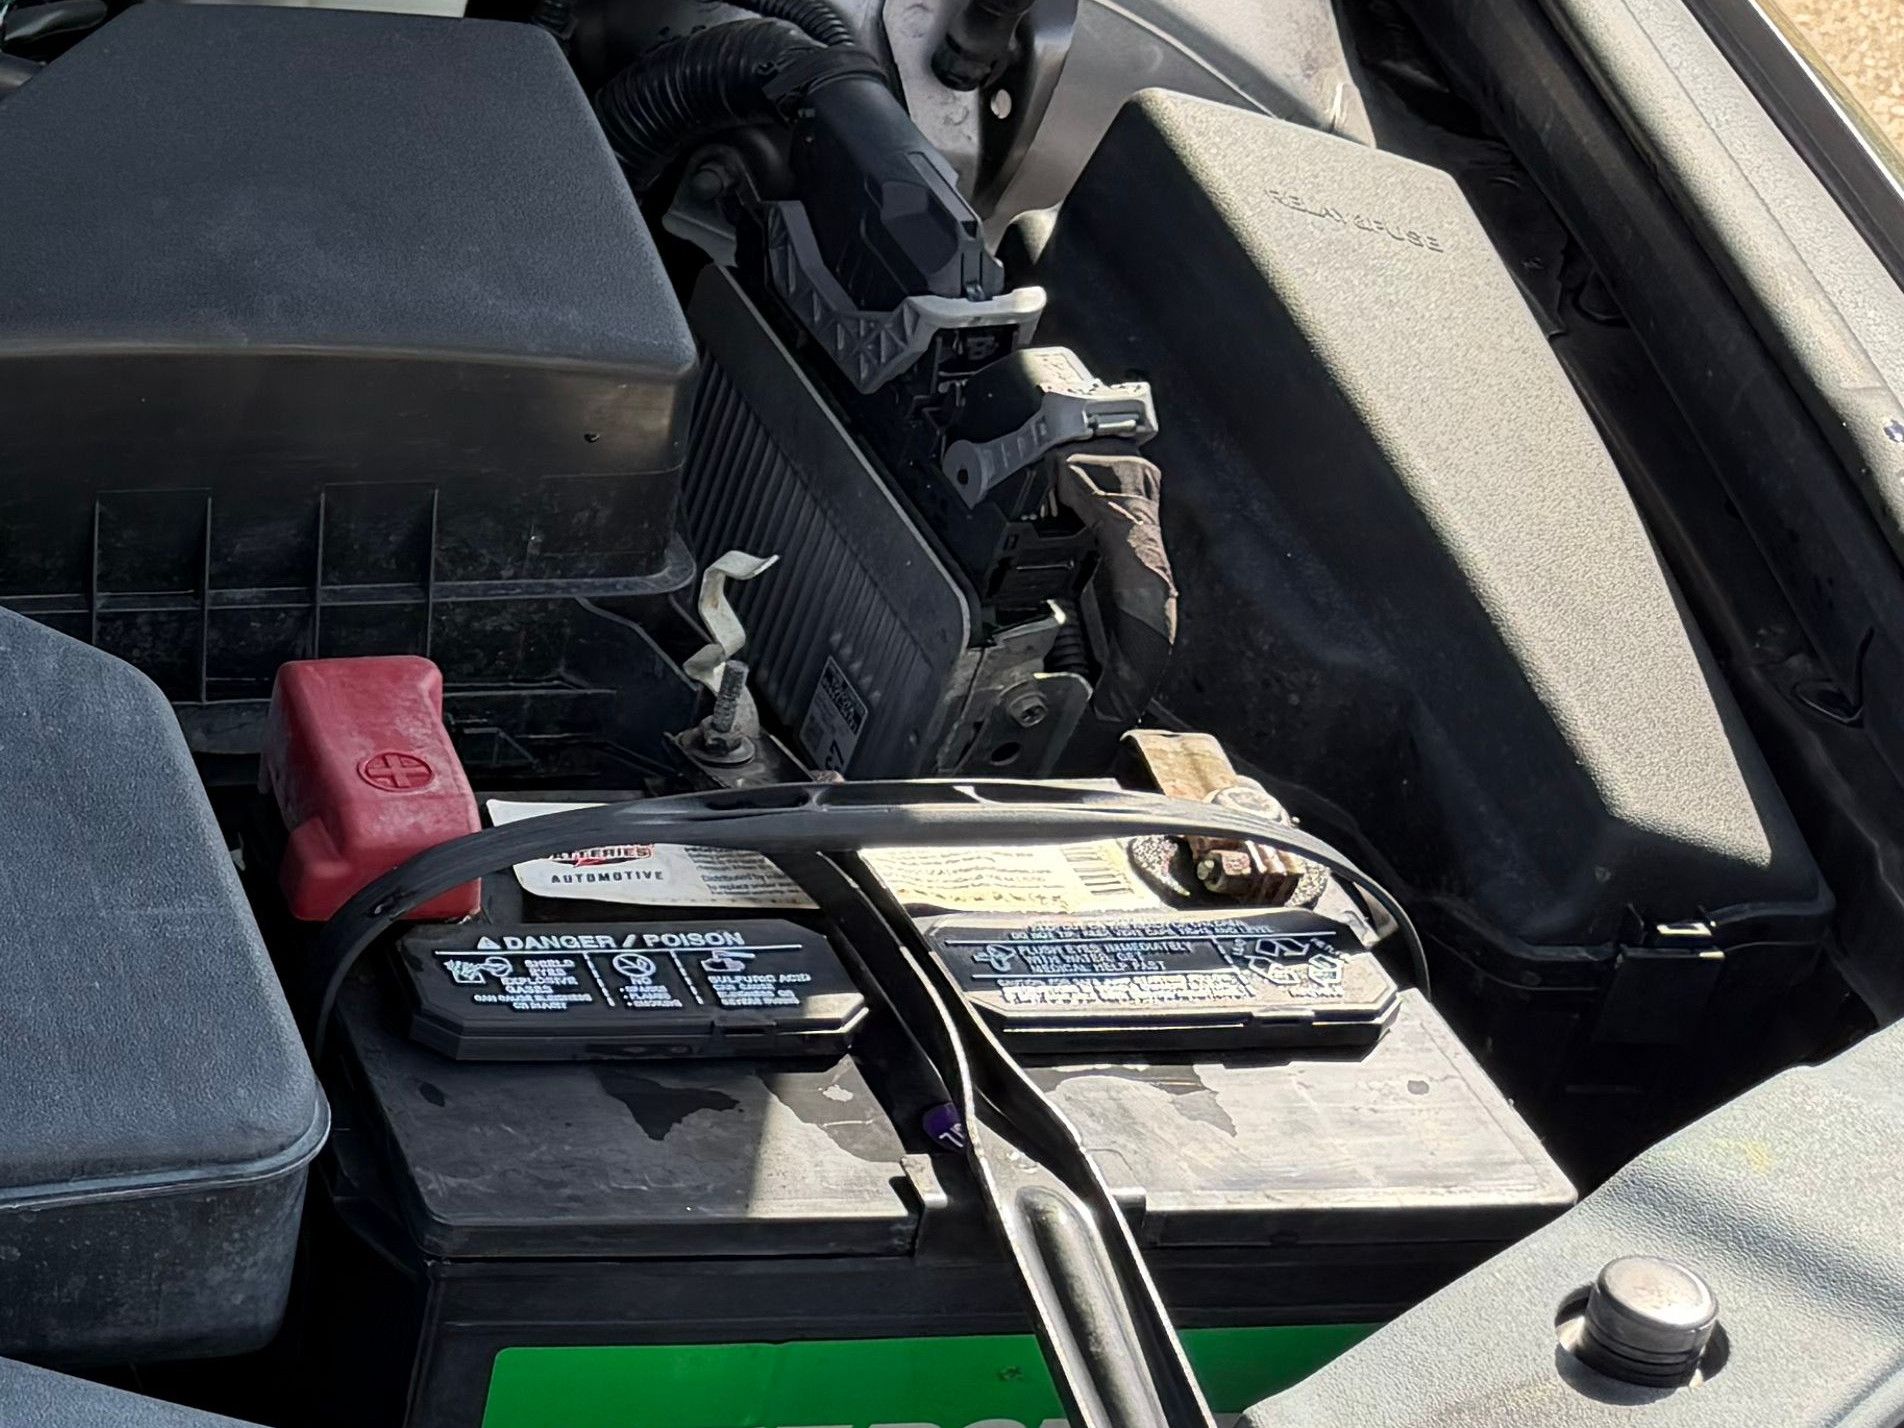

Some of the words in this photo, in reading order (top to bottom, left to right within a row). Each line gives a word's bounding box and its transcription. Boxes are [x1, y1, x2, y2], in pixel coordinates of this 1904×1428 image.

[551, 871, 664, 883] AUTOMOTIVE
[502, 935, 618, 950] DANGER
[642, 932, 746, 948] POISON
[1017, 945, 1062, 956] FLUSH
[1102, 941, 1193, 953] IMMEDIATELY
[1030, 963, 1093, 974] MEDICAL
[1092, 962, 1129, 972] HELP
